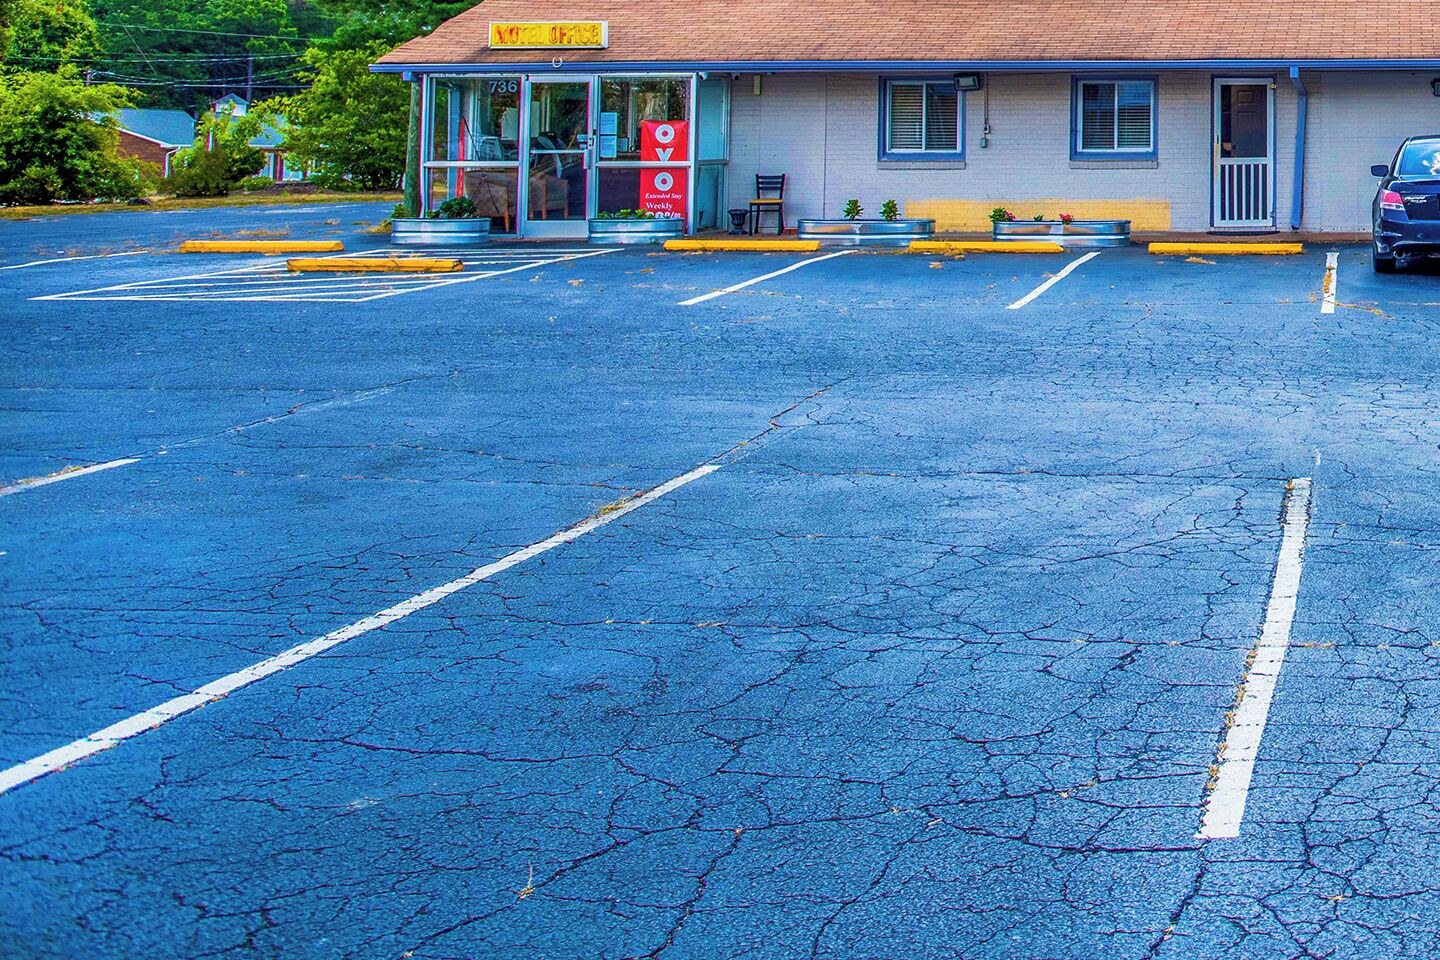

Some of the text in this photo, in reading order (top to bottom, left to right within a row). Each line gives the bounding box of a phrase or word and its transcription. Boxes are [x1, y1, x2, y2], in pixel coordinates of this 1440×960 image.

[495, 25, 599, 44] MOTEL OFFICE
[489, 80, 517, 93] 736
[654, 124, 675, 191] OYO
[646, 202, 672, 210] Weekly
